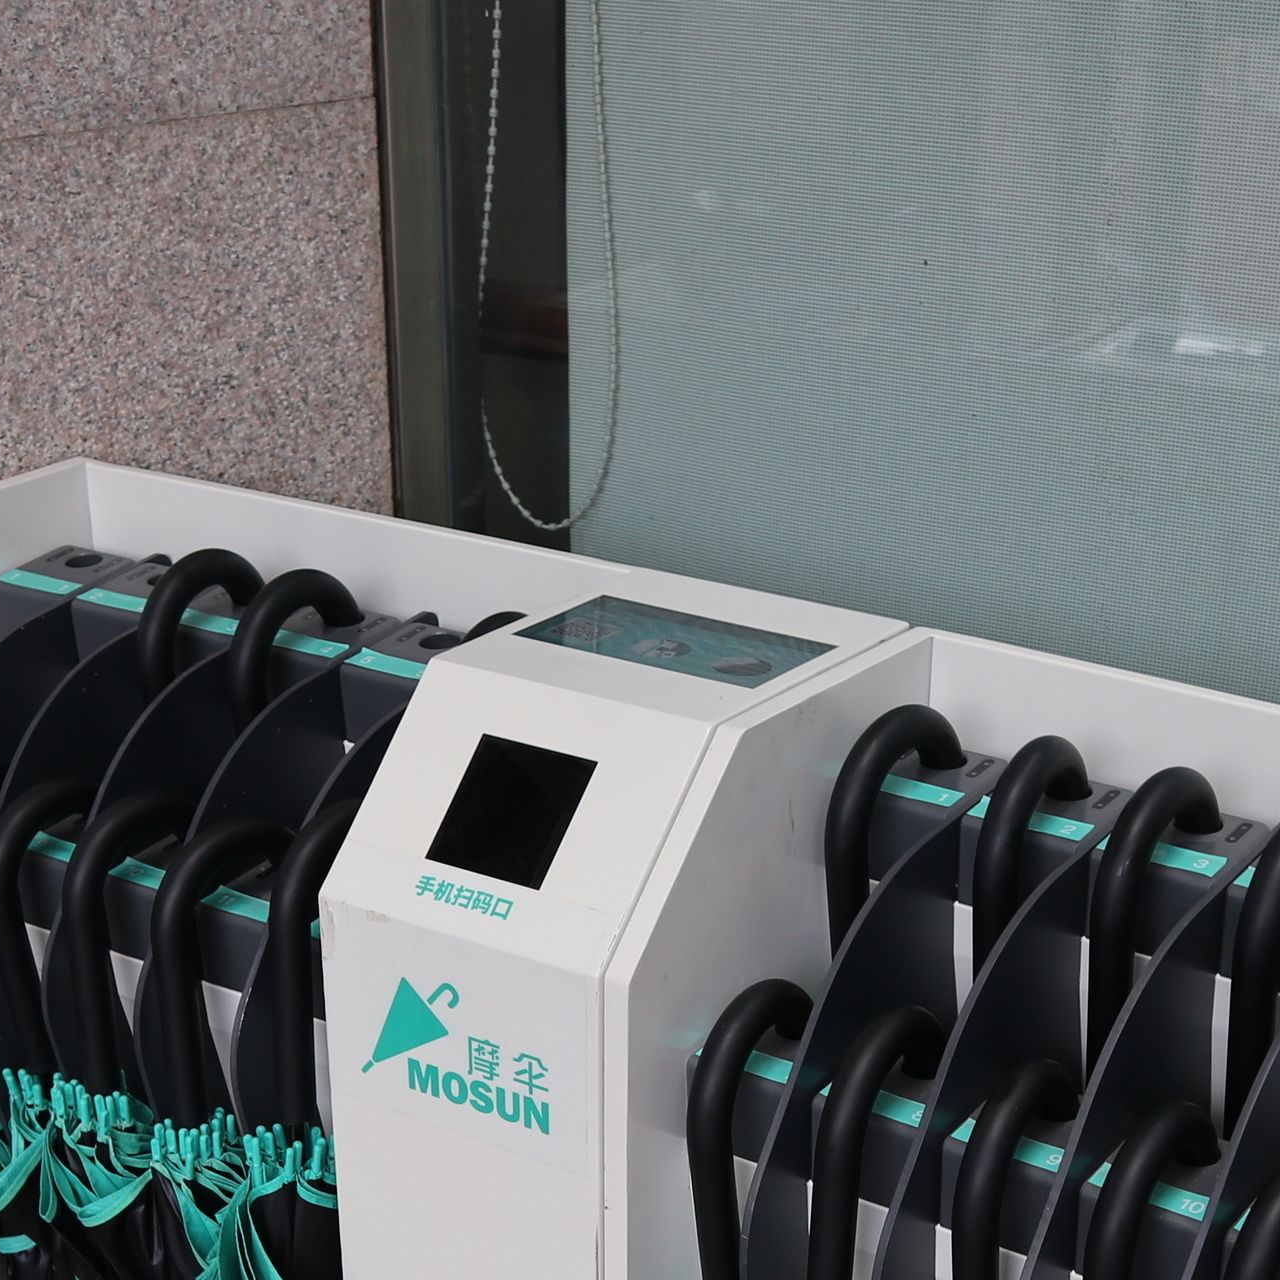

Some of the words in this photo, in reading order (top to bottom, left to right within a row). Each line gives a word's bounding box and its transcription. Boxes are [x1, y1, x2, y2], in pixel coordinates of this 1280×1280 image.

[938, 793, 949, 802] 1
[1059, 824, 1077, 835] 2
[1193, 858, 1209, 869] 3
[415, 875, 514, 920] 手机扫码口
[467, 1036, 549, 1095] 摩伞
[407, 1057, 550, 1135] MOSUN
[1046, 1154, 1062, 1166] 9
[1180, 1198, 1205, 1214] 10
